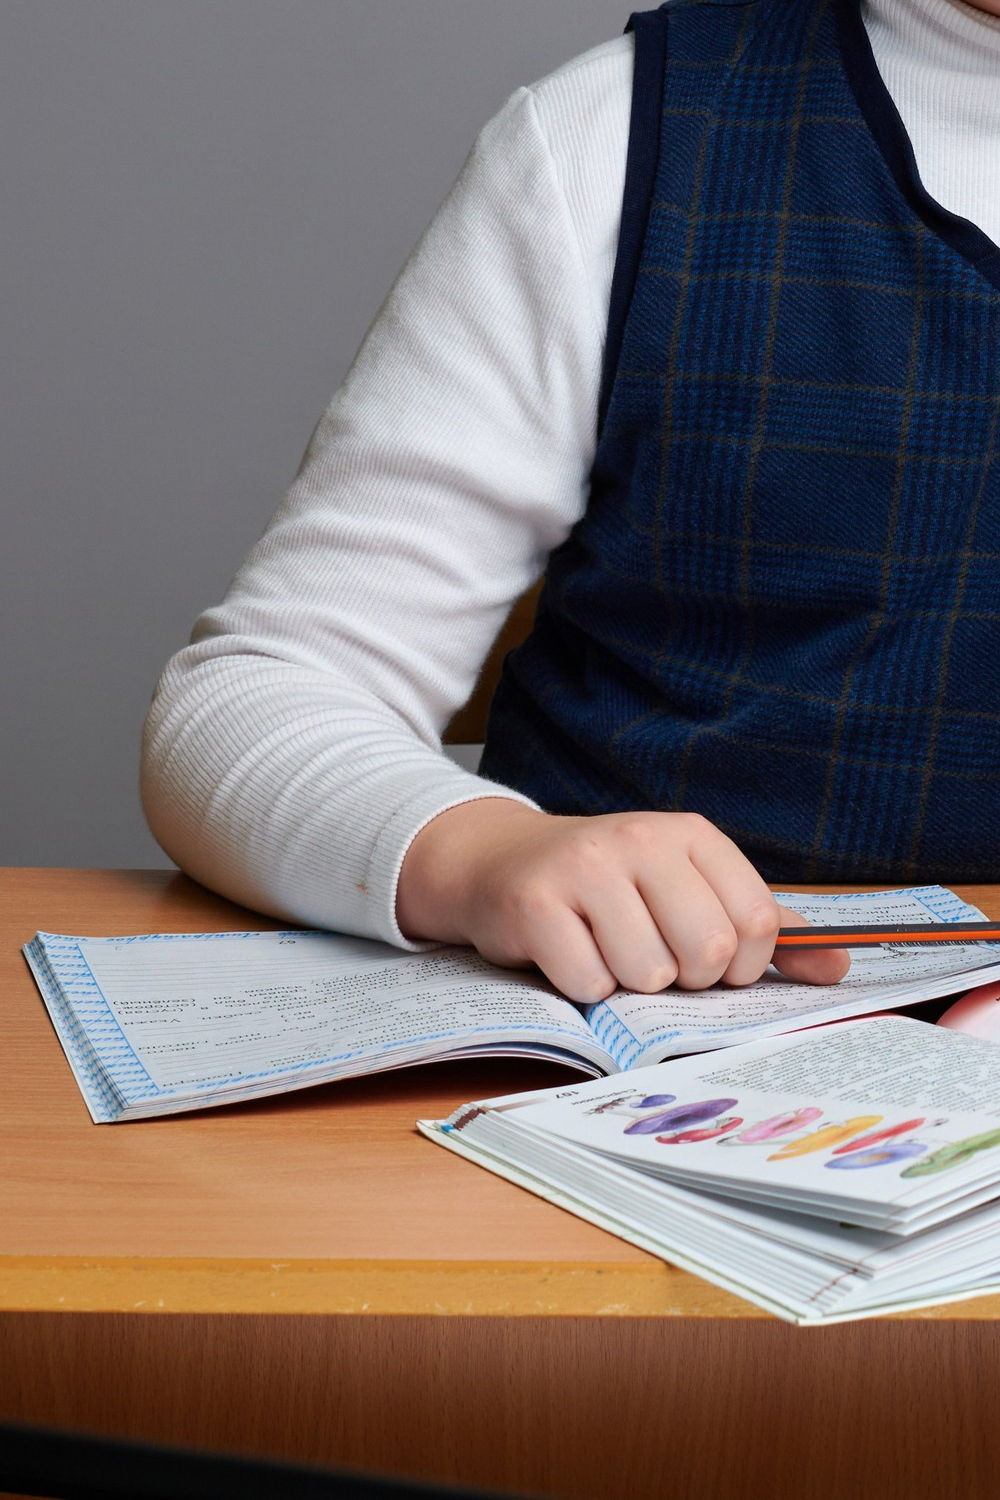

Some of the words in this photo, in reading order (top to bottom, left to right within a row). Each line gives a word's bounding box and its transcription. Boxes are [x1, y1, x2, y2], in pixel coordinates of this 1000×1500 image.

[123, 1018, 180, 1026] Укажи
[162, 1071, 242, 1088] Подбери
[571, 1088, 637, 1106] Сыроежки
